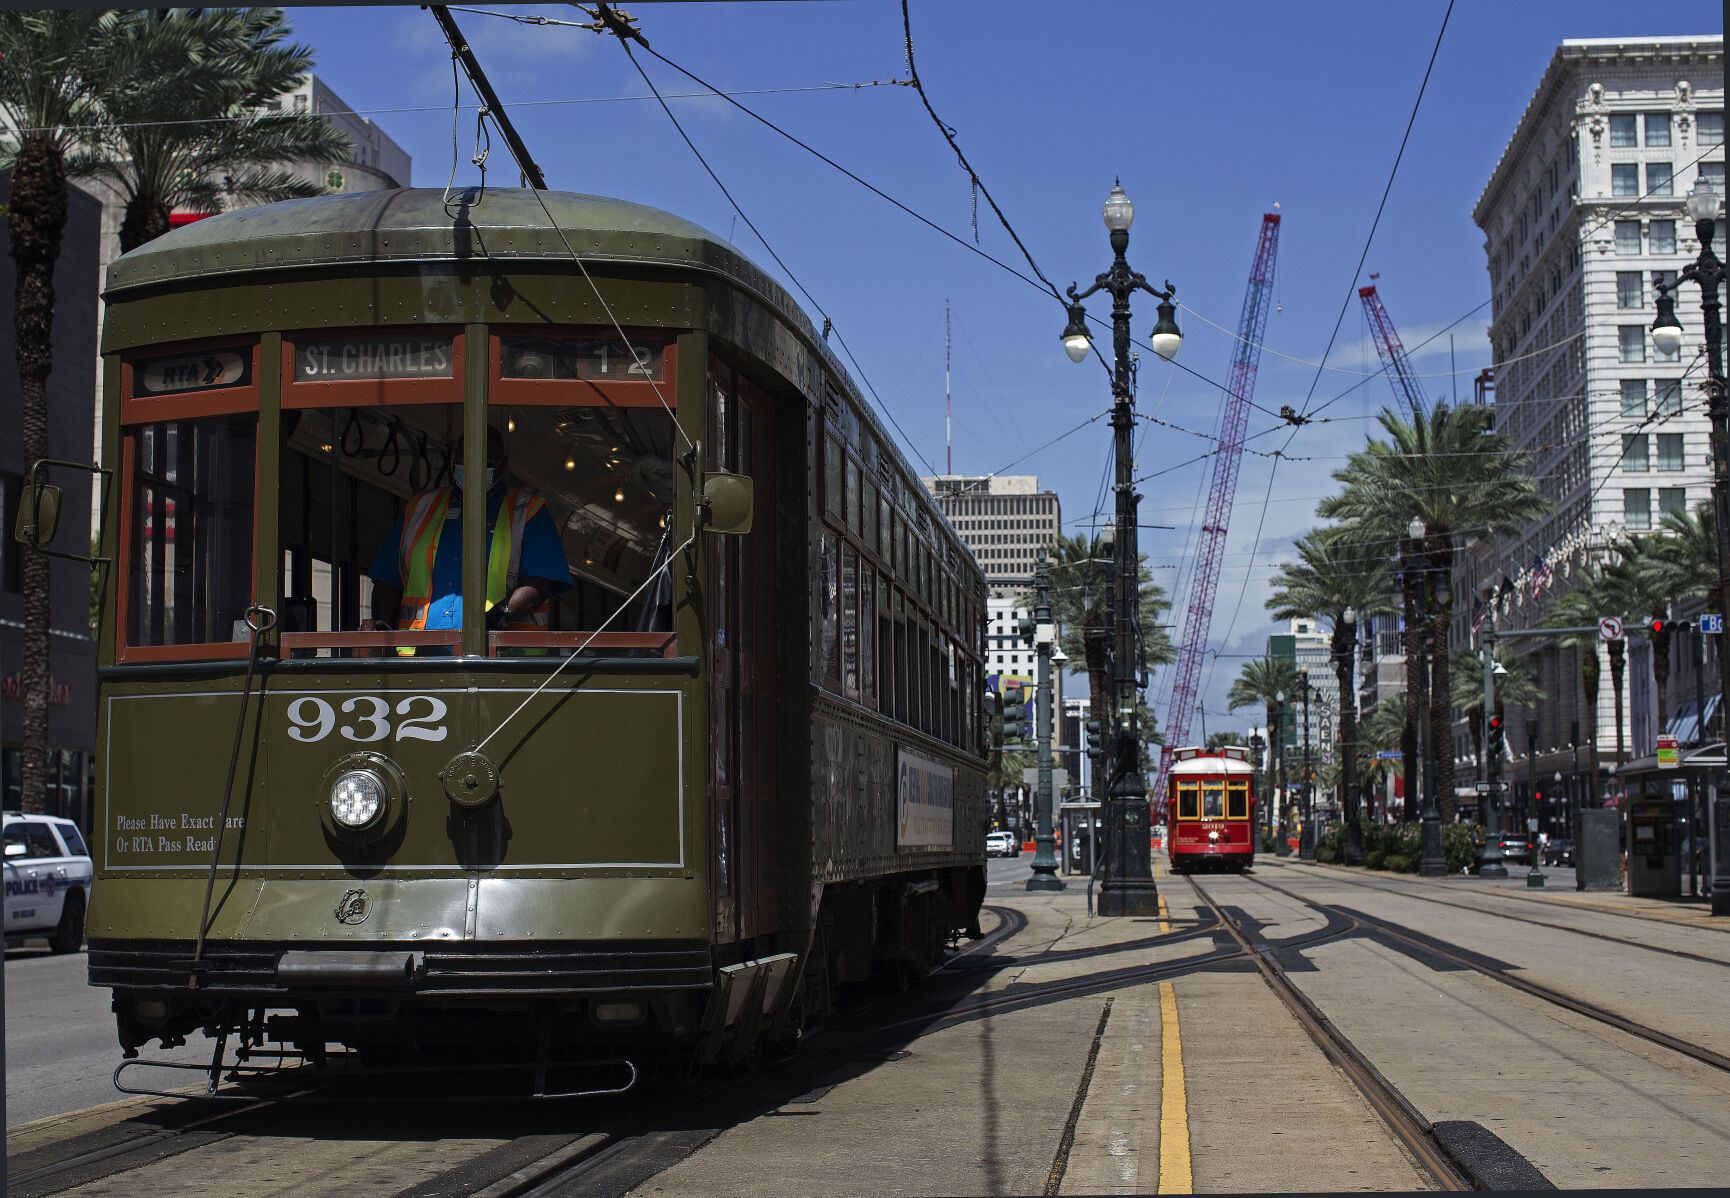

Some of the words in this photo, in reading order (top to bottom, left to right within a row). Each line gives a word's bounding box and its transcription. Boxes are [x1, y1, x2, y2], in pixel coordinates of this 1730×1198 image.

[305, 344, 336, 375] ST.
[342, 340, 448, 374] CHARLES
[163, 363, 199, 384] RTA
[286, 695, 448, 743] 932
[117, 815, 146, 830] Please
[150, 814, 177, 830] Have
[181, 813, 214, 829] Exact
[219, 812, 246, 829] are
[116, 837, 129, 853] Or
[132, 836, 154, 852] RTA
[158, 836, 182, 852] Pass
[186, 835, 217, 852] Read
[6, 879, 39, 896] POLICE
